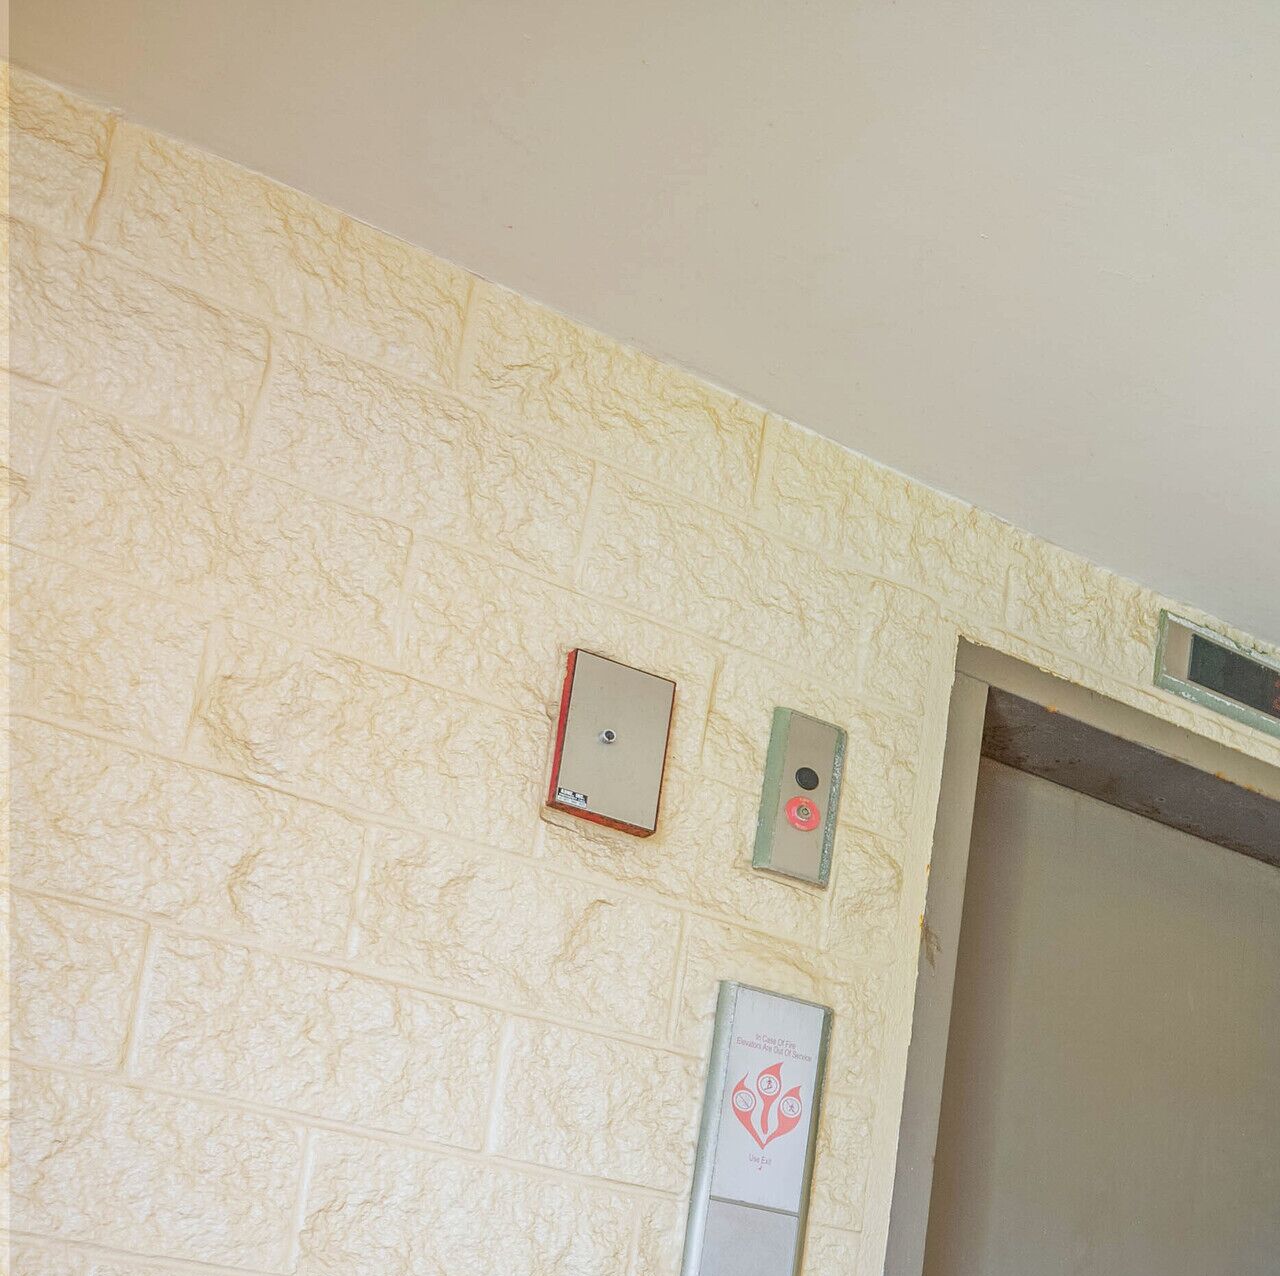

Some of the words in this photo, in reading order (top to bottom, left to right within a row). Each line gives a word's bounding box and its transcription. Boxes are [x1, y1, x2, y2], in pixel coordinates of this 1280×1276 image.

[762, 1034, 777, 1046] Case
[785, 1040, 797, 1050] Fire
[772, 1045, 784, 1056] Out
[749, 1153, 760, 1164] Use
